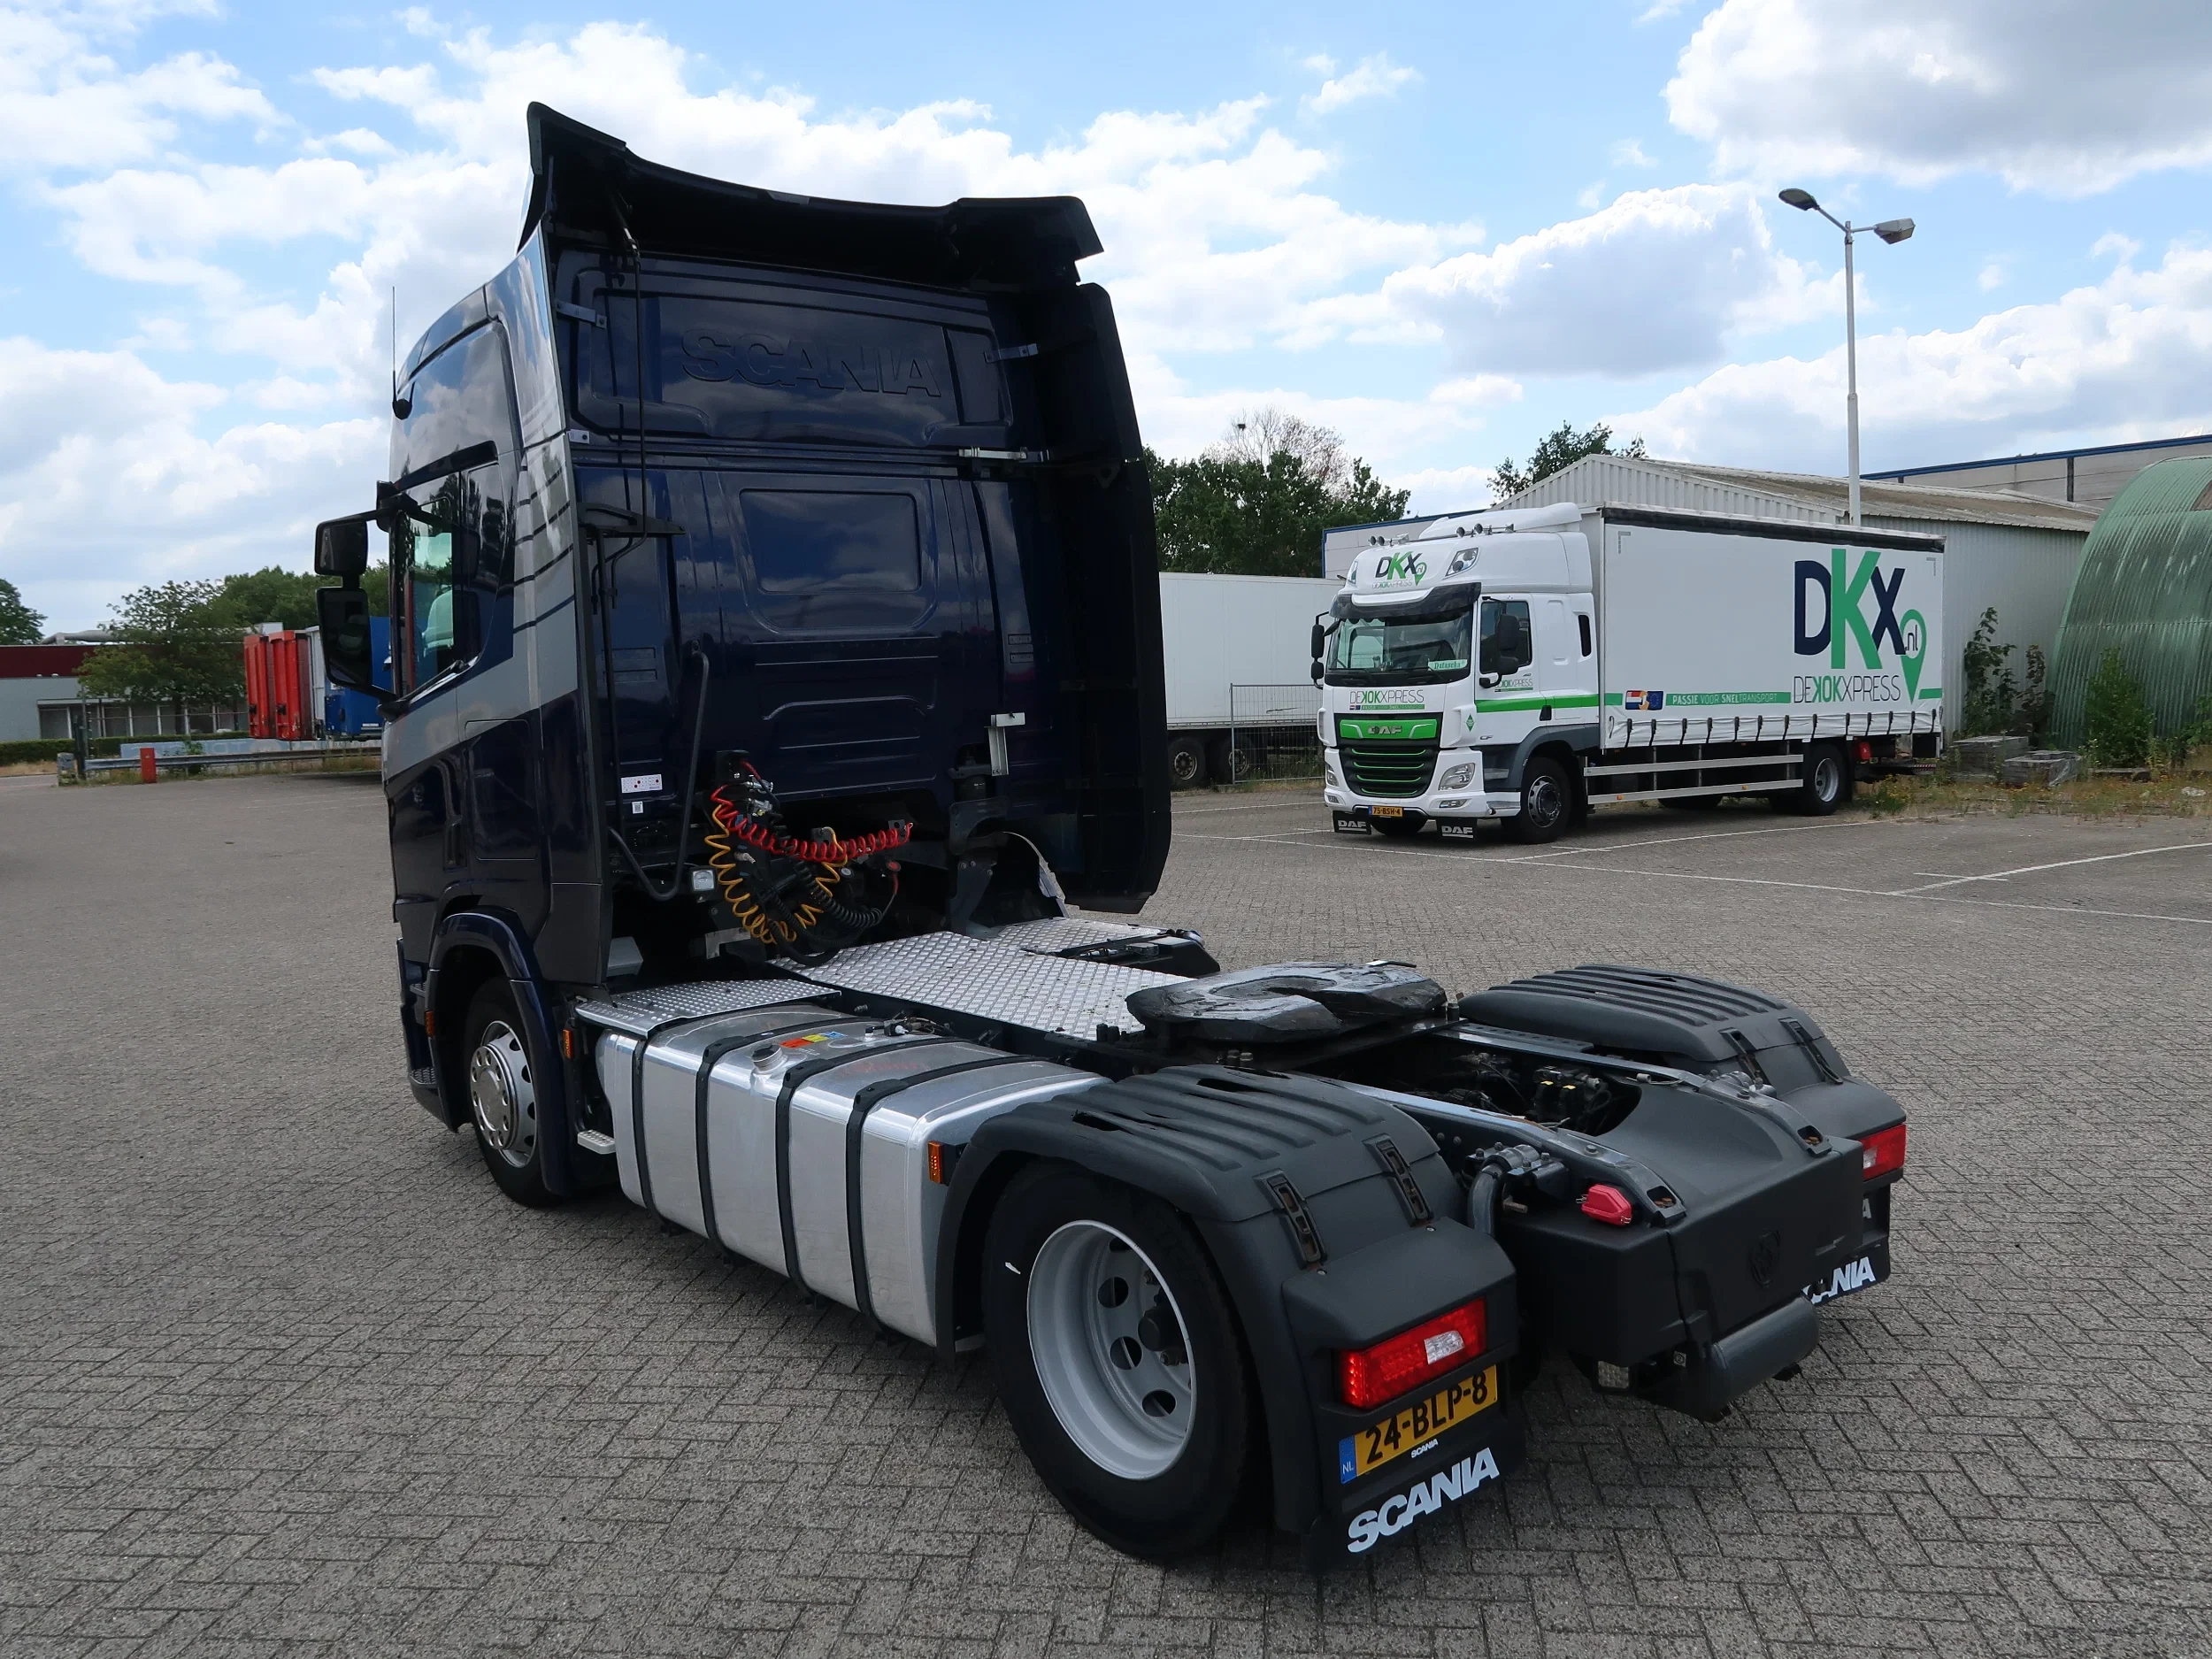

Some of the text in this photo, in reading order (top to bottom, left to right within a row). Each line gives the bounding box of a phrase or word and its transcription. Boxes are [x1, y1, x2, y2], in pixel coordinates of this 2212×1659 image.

[681, 328, 942, 398] SCANIA
[1793, 549, 1907, 670] DKX
[1349, 690, 1425, 704] DEKOKXPRESS
[1793, 675, 1901, 703] DEKOKXPRESS
[1672, 694, 1778, 705] PASSIE VOOR SNELTRANSPORT
[1367, 726, 1402, 735] DAF
[1338, 819, 1367, 828] DAF
[1440, 826, 1473, 834] DAF
[1364, 1371, 1488, 1465] 24-BLP-8
[1410, 1438, 1439, 1458] SCANIA
[1342, 1464, 1355, 1475] NL
[1347, 1447, 1501, 1554] SCANIA
